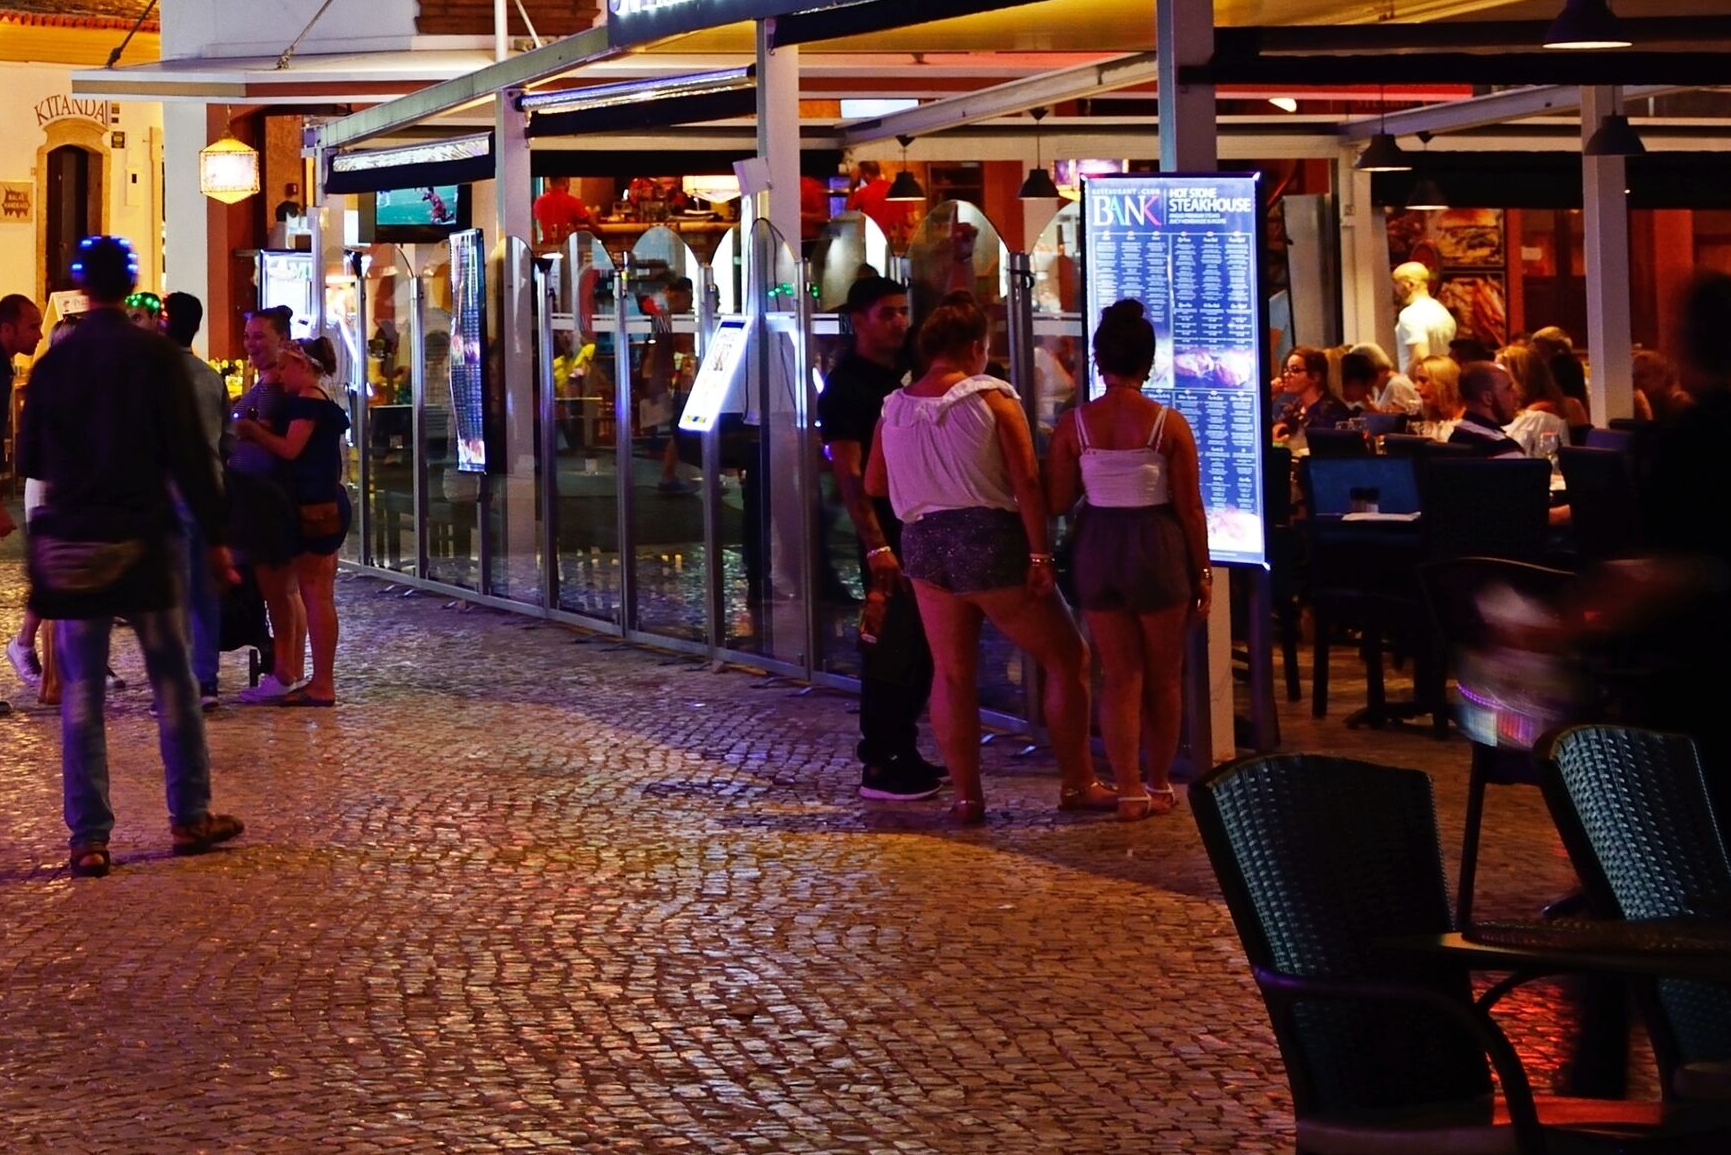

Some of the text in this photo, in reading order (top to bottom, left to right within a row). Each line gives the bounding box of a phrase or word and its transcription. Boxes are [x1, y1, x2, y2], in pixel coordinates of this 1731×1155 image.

[33, 94, 107, 127] KITANDA
[1169, 188, 1217, 198] HOT STONE
[1092, 195, 1162, 226] BANK
[1169, 198, 1252, 212] STEAKHOUSE
